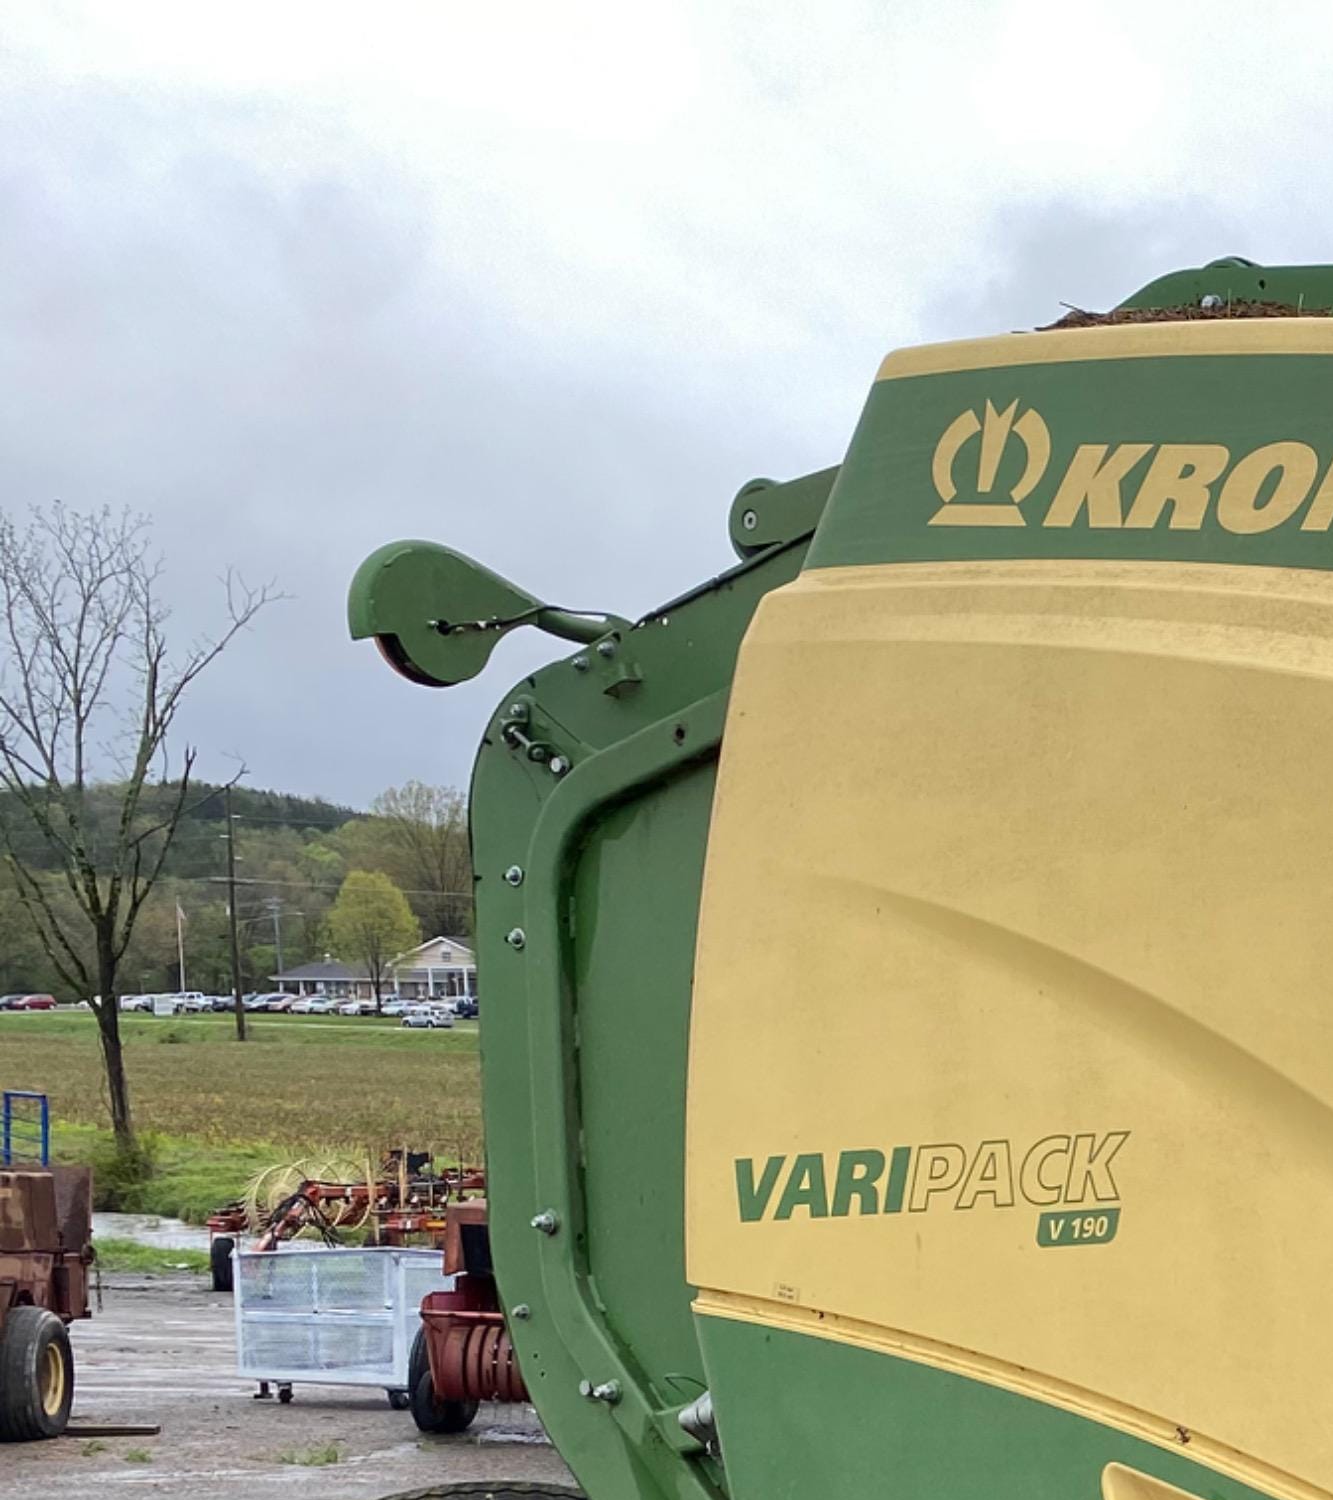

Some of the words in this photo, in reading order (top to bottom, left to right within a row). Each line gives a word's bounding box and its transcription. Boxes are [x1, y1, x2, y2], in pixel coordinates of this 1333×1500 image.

[734, 1131, 1131, 1223] VARIPACK
[1049, 1218, 1065, 1240] V
[1071, 1215, 1108, 1239] 190
